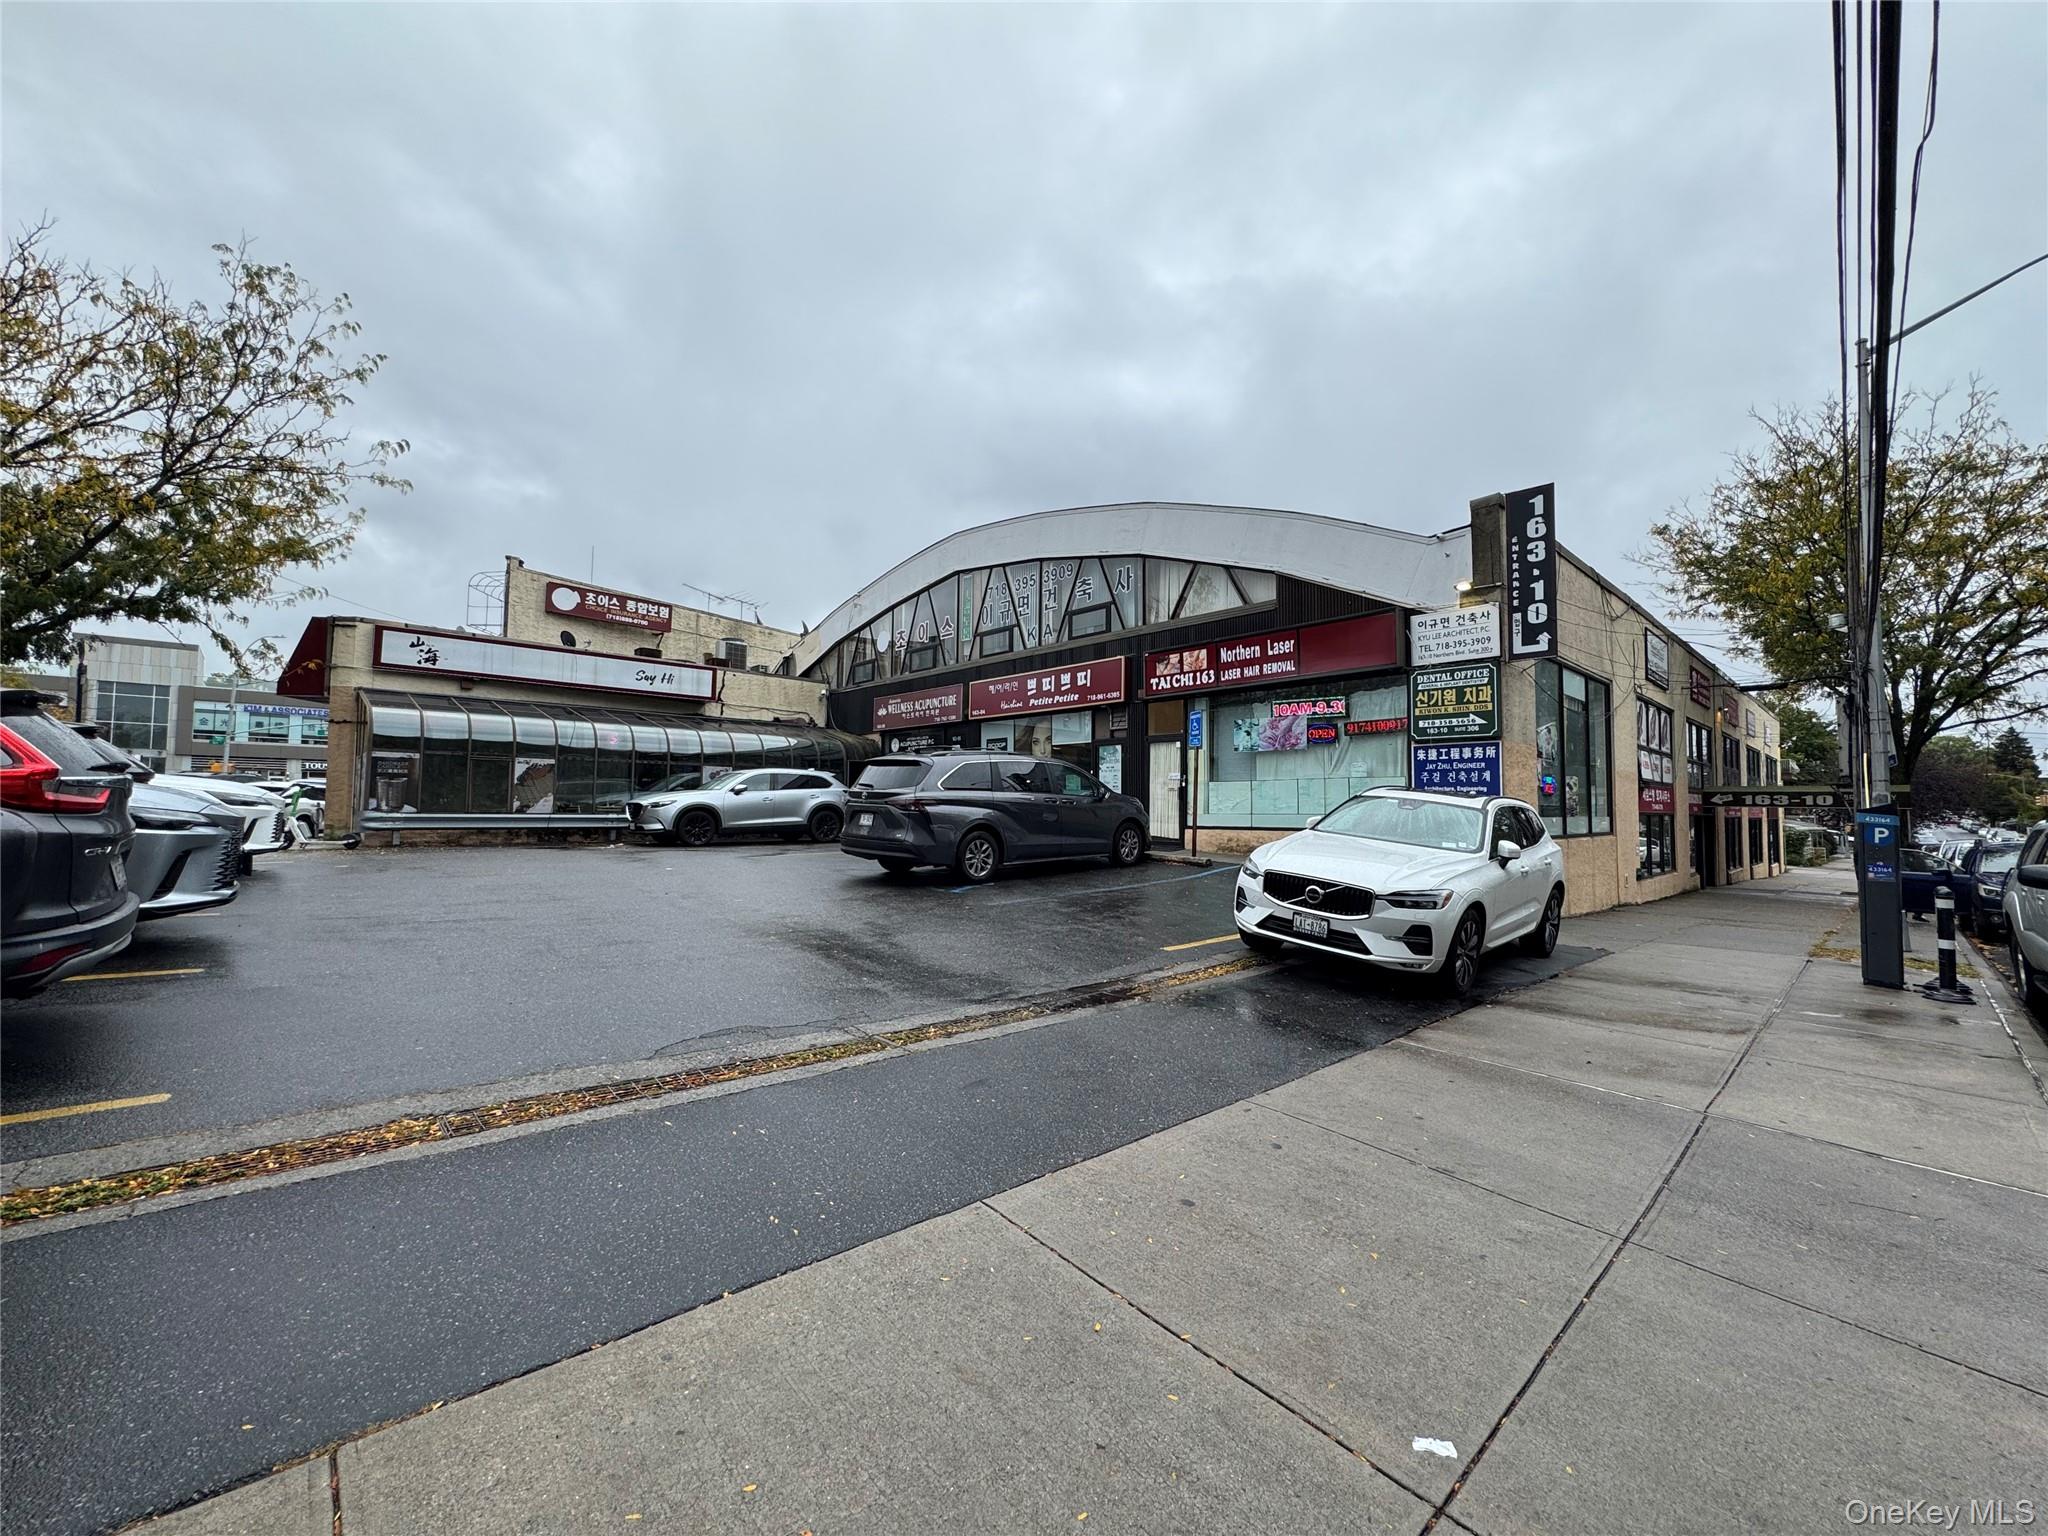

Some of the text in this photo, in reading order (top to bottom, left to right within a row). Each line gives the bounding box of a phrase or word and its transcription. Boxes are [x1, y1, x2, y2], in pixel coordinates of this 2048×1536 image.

[988, 562, 1075, 600] 718 395 3909
[584, 592, 670, 619] 초이스 종합보험
[1417, 610, 1491, 630] 이규면 건축사
[1417, 633, 1431, 642] KYU
[1432, 631, 1441, 640] LEE
[1220, 639, 1295, 664] Northern Laser
[635, 668, 675, 685] Say Hi
[1220, 660, 1296, 681] LASER HAIR REMOVAL
[1417, 668, 1490, 684] DENTAL OFFICE
[1150, 669, 1215, 691] TAI CHI 163
[887, 694, 958, 714] WELLNESS ACUPUNCTURE
[1028, 695, 1053, 707] Petite
[1053, 692, 1080, 704] Petite
[1415, 685, 1493, 708] 신기원 치과
[243, 704, 262, 713] KIM
[271, 706, 329, 718] ASSOCIATES
[1418, 706, 1442, 715] KIWON
[1473, 703, 1489, 711] DDS
[1308, 728, 1336, 739] OPEN
[1741, 794, 1834, 806] 163-10
[1865, 815, 1891, 823] 433164
[1874, 827, 1890, 844] P
